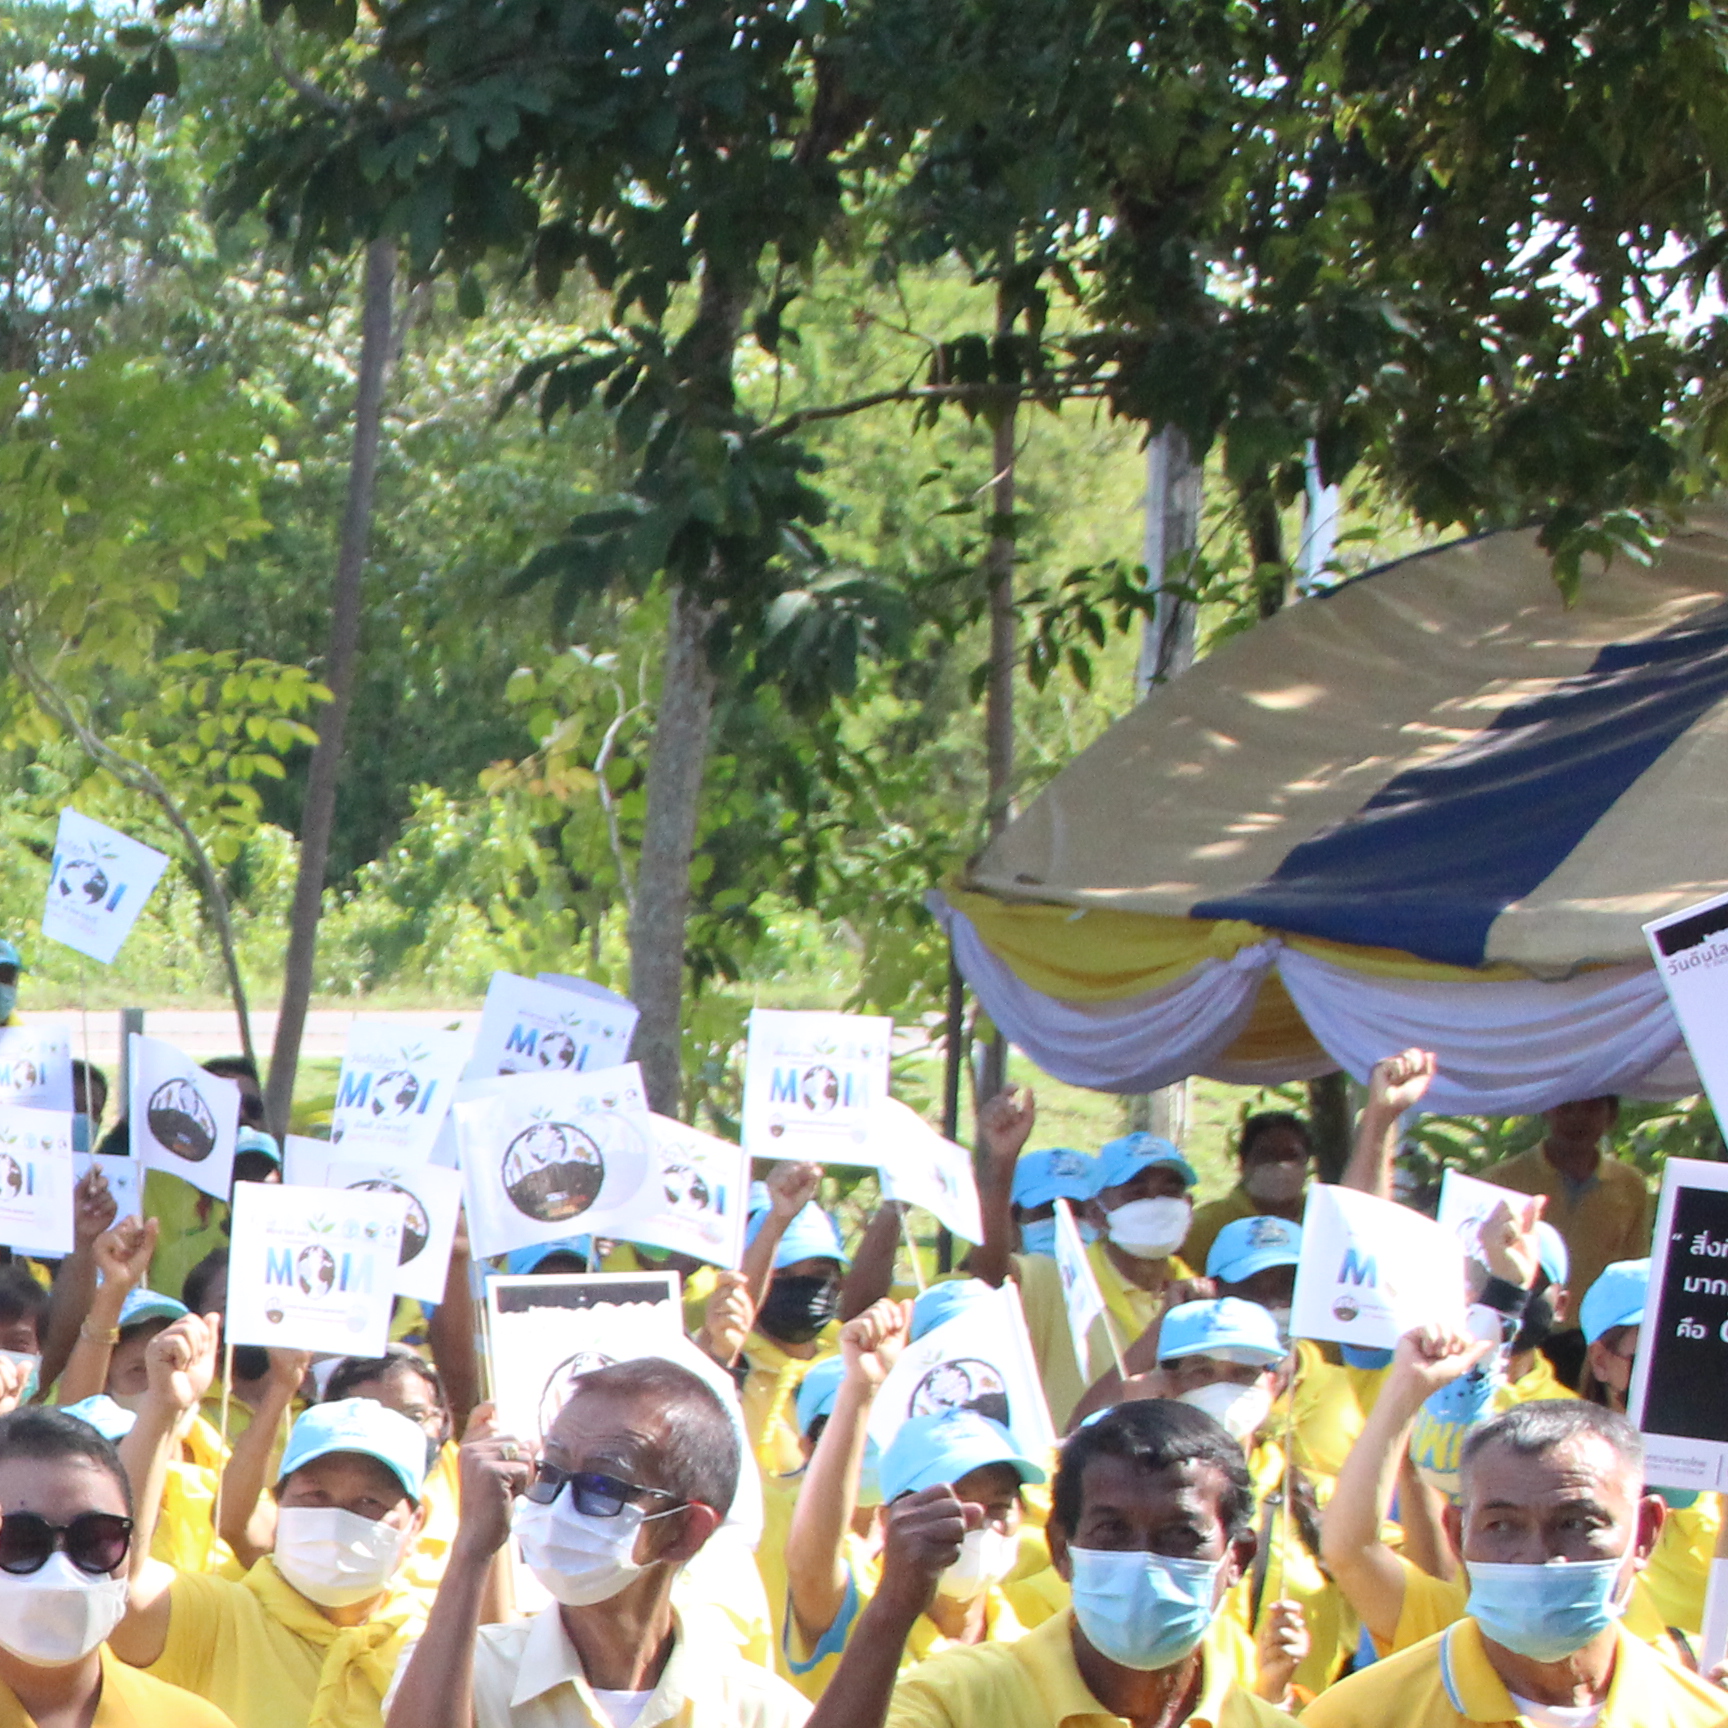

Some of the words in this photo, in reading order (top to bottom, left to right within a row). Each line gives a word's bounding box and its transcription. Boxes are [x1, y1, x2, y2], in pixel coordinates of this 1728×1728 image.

[49, 853, 128, 913] OI
[1667, 944, 1728, 976] วันดินโล
[663, 1163, 727, 1217] OI
[1676, 1316, 1707, 1340] คือ
